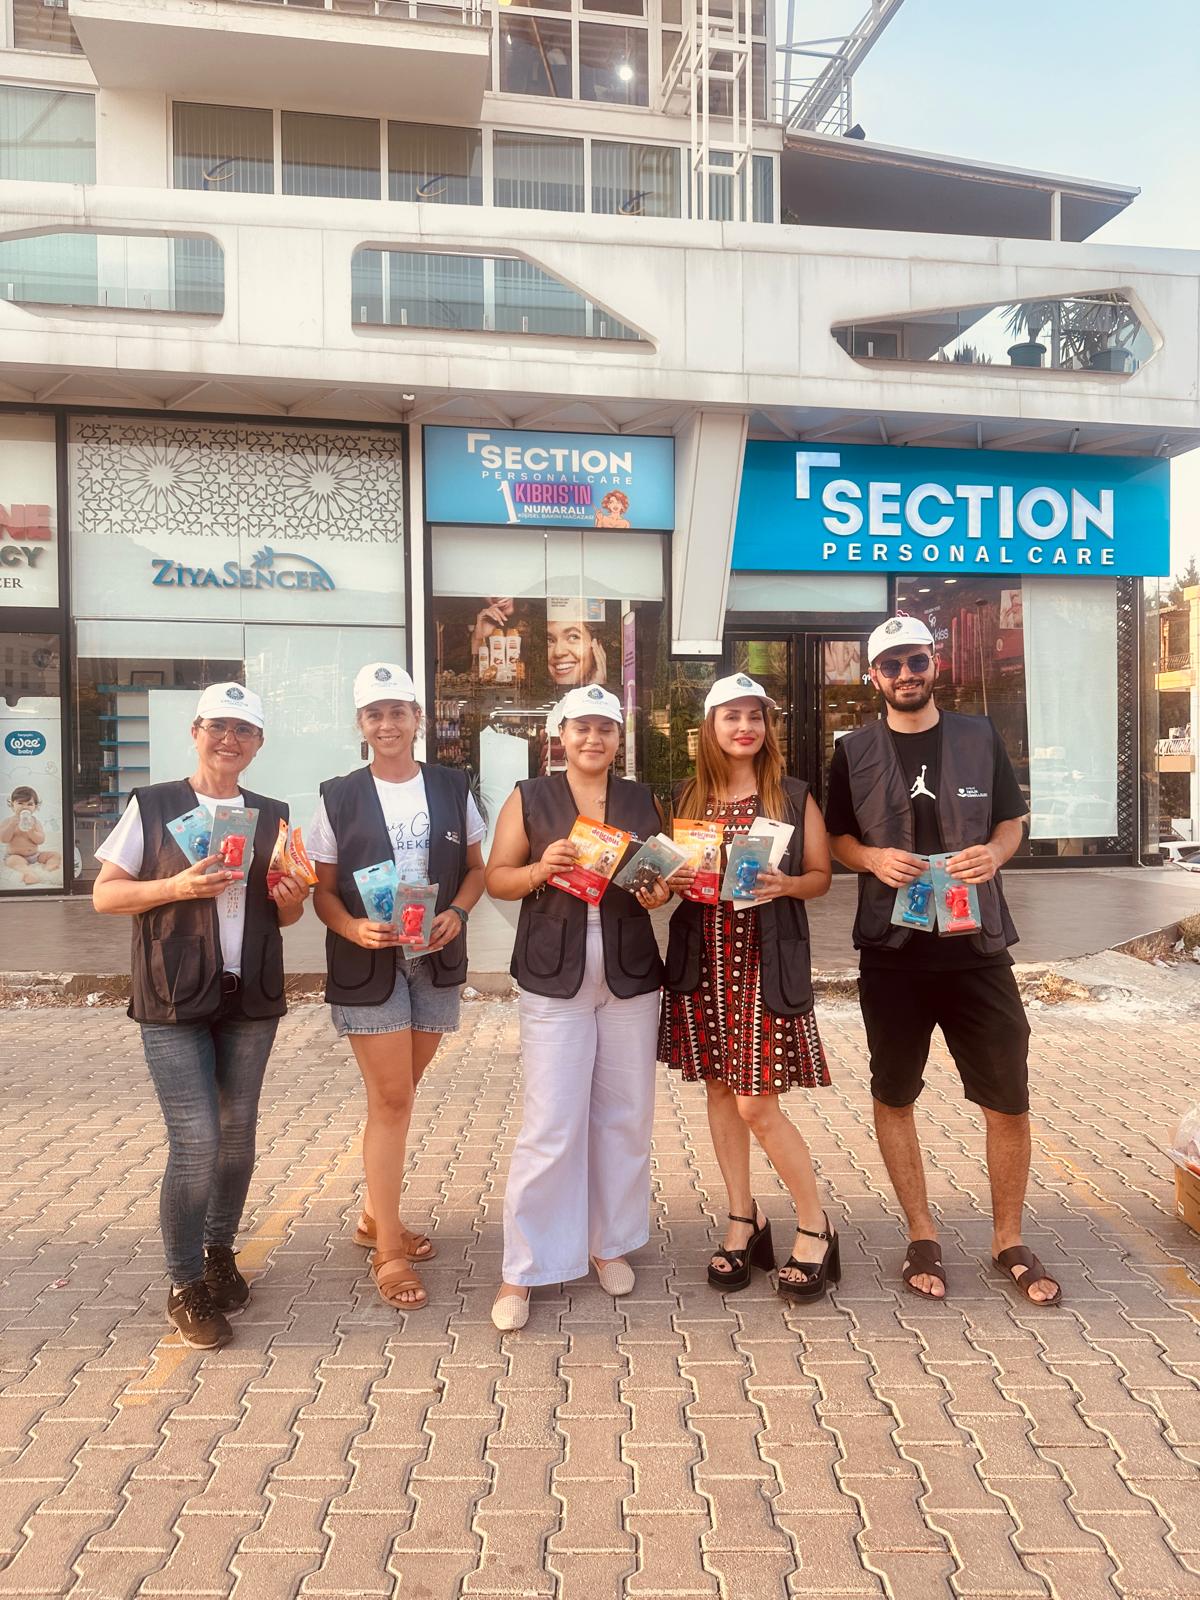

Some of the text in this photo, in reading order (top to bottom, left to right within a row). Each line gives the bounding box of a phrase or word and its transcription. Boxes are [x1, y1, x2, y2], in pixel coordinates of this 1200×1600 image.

[481, 445, 632, 474] SECTION
[482, 470, 632, 485] PERSONAL CARE
[524, 505, 585, 515] NUMARALI
[821, 479, 1115, 541] SECTION
[822, 542, 1115, 565] PERSONAL CARE
[0, 577, 23, 589] ER
[392, 840, 430, 851] REKE
